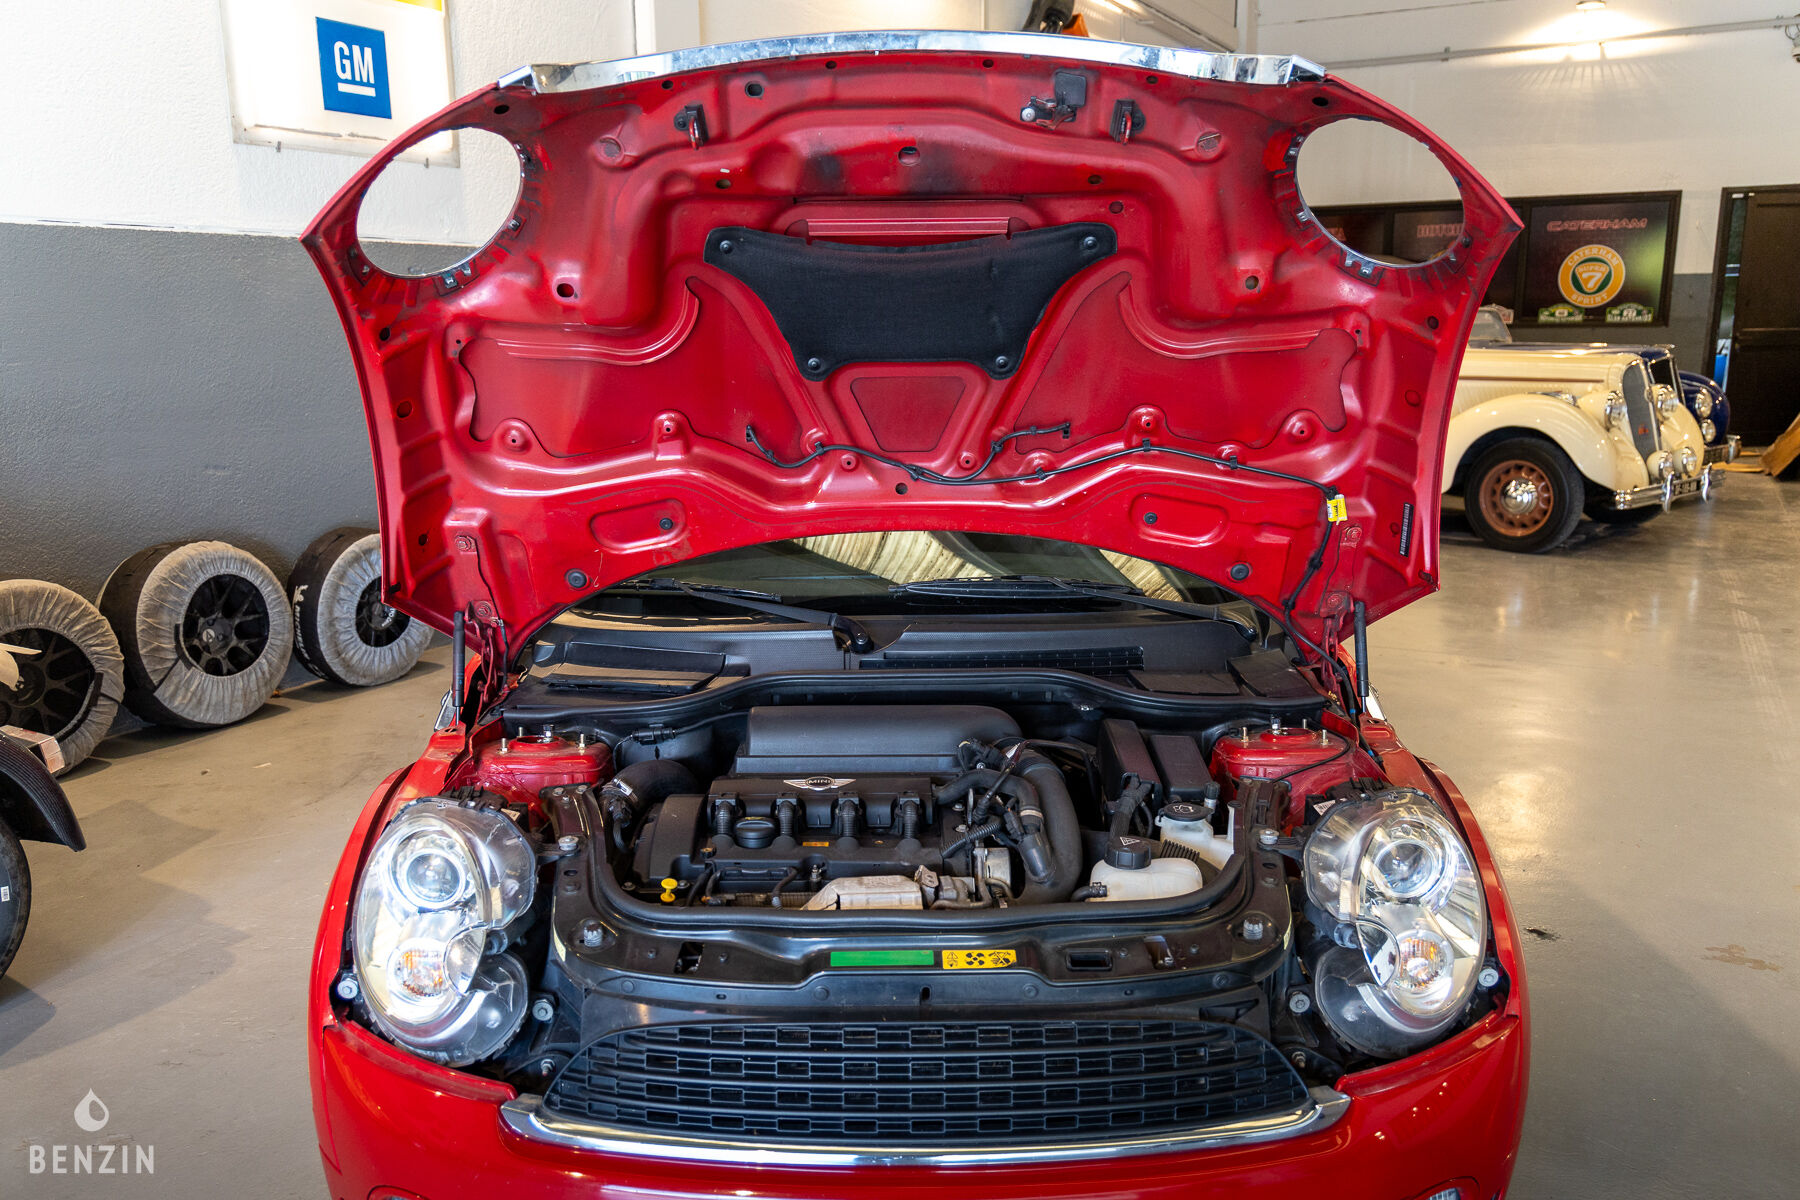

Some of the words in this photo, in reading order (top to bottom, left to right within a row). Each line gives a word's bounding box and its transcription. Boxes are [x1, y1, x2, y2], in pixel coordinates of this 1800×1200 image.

[333, 40, 375, 84] GM
[1547, 218, 1648, 232] CATERHAM
[1567, 247, 1621, 266] CATERHAM
[1582, 272, 1602, 288] 7
[1571, 292, 1608, 304] SPRINT
